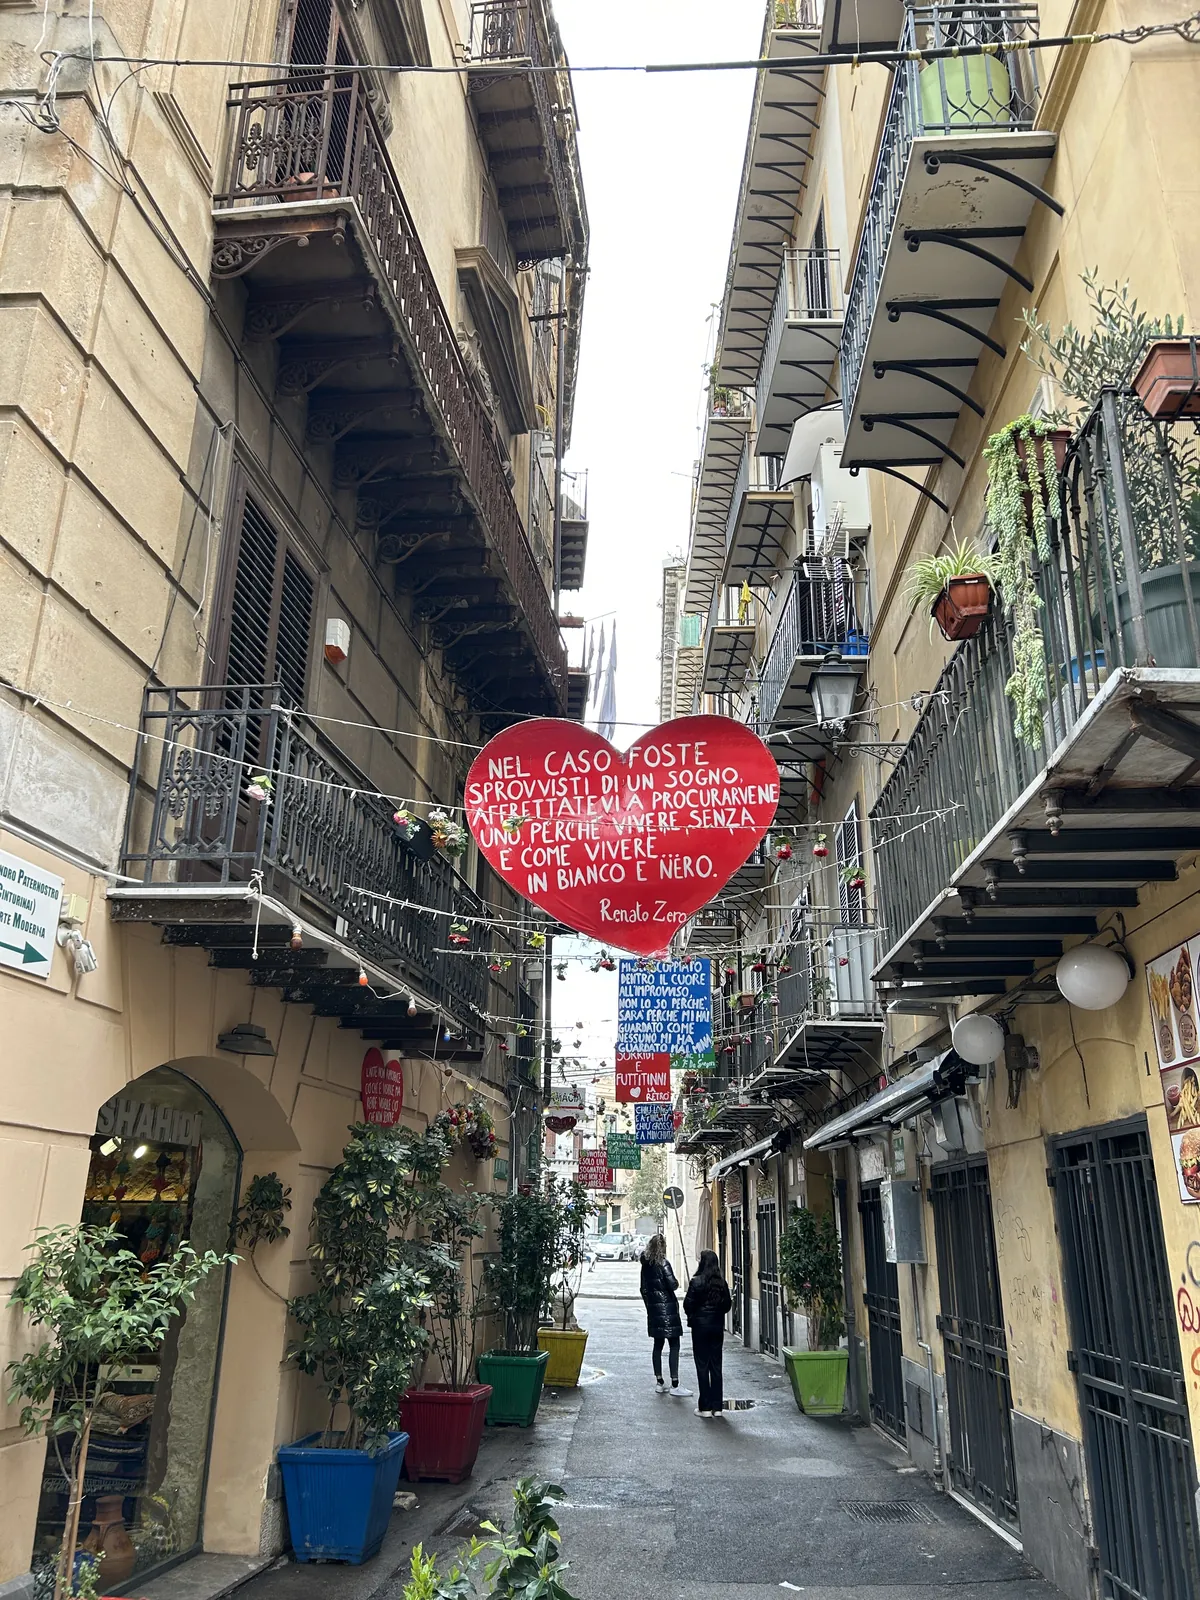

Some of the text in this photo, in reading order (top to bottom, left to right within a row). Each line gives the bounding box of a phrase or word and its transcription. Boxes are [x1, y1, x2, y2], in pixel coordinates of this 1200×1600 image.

[488, 741, 709, 780] NEL CASO FOSTE
[469, 767, 743, 805] SPROVVISTI DI UN SOGNO,
[626, 793, 644, 811] A
[652, 783, 779, 810] PROCURARVENE
[612, 811, 681, 836] VIVERE
[688, 806, 755, 828] SENZA
[520, 844, 571, 869] COME
[527, 854, 718, 894] IN BIANCO E NERO.
[599, 898, 687, 923] Renato Zero
[620, 973, 706, 985] DENTRO IL CUORE
[619, 998, 638, 1009] NON
[641, 998, 651, 1009] LO
[654, 998, 667, 1009] SO
[682, 1010, 695, 1022] MI
[696, 1010, 710, 1022] HAI
[618, 1022, 695, 1034] GUARDATO COME
[618, 1033, 694, 1045] NESSUNO MI HA
[618, 1043, 668, 1053] GUARDATO
[635, 1061, 642, 1072] E
[616, 1072, 667, 1086] FUTTITINNI
[98, 1098, 202, 1147] SHAHIDI
